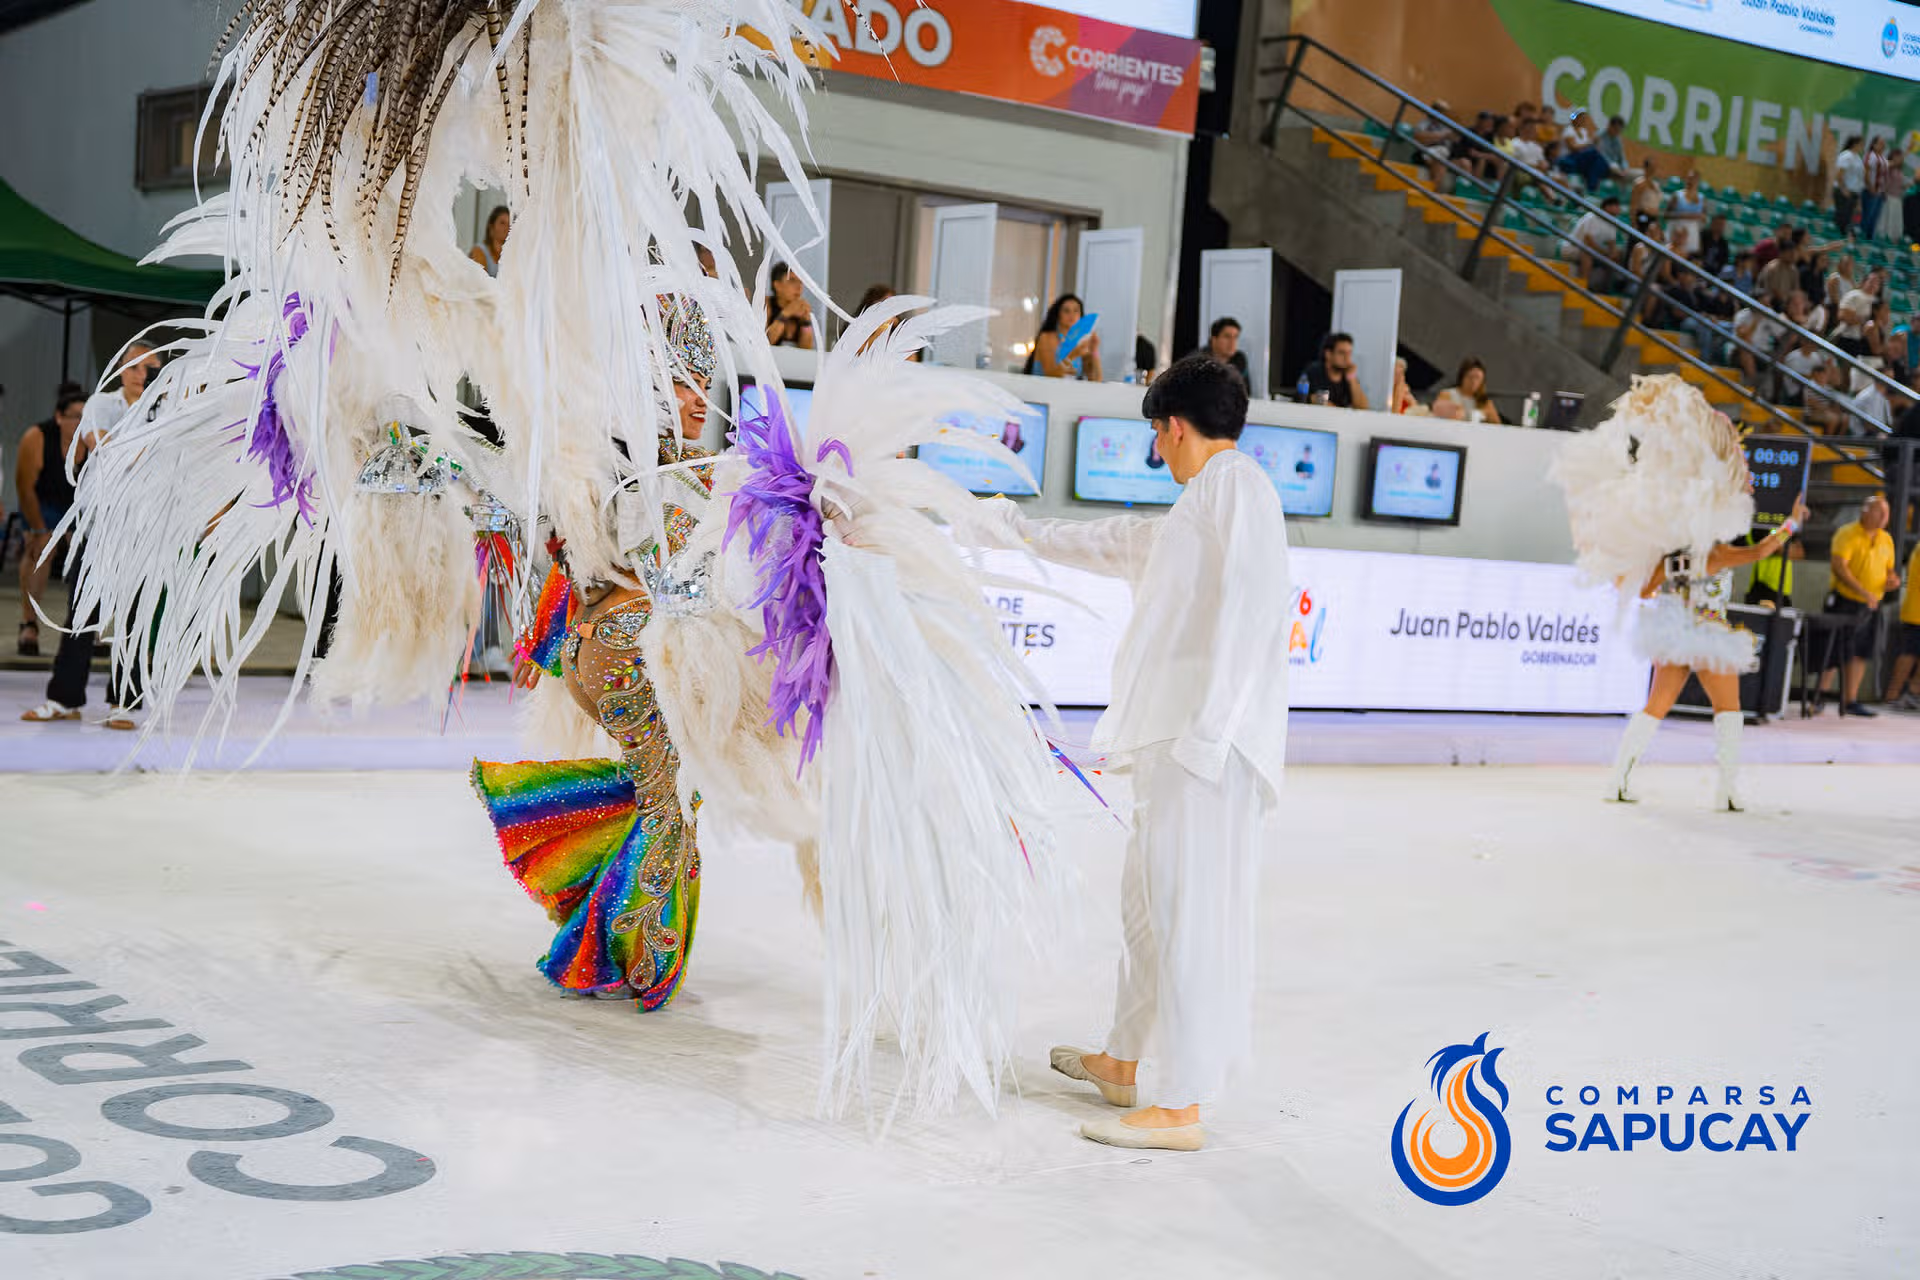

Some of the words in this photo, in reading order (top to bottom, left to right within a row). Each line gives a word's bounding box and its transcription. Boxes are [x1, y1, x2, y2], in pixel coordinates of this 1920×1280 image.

[790, 0, 951, 67] ADO
[1066, 46, 1184, 87] CORRIENTES
[1390, 607, 1450, 638] Juan
[1456, 611, 1521, 641] Pablo
[1526, 611, 1600, 644] Valdés
[1521, 650, 1597, 666] GOBERNADOR
